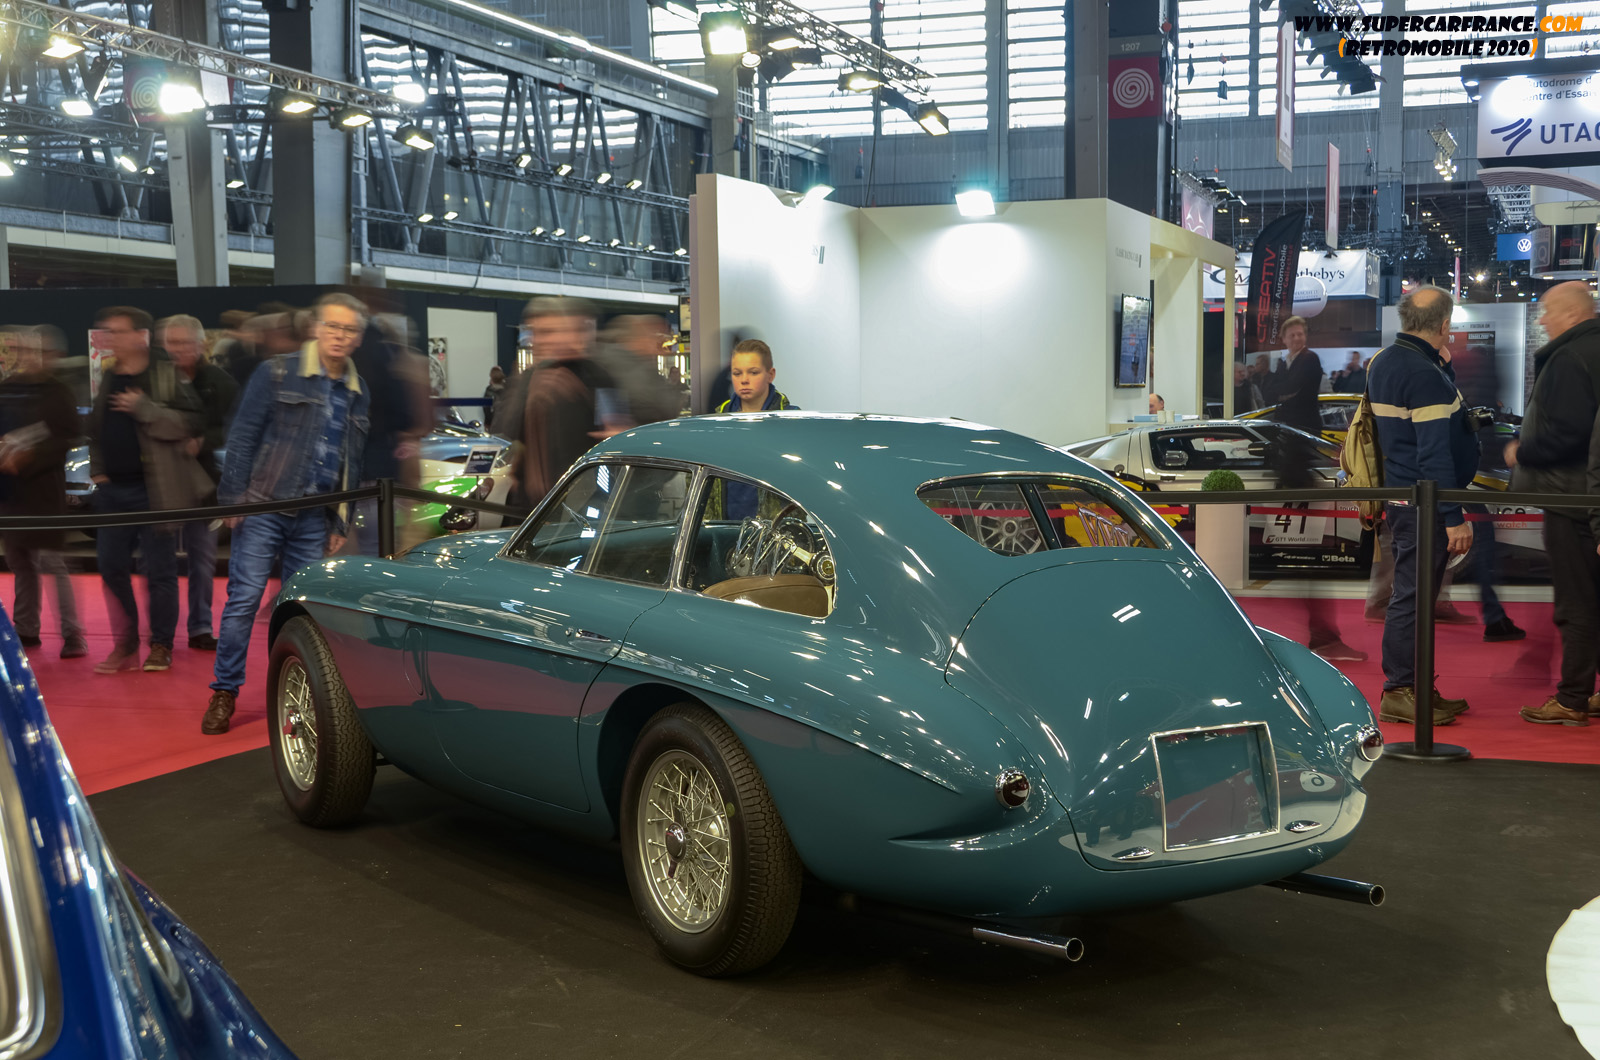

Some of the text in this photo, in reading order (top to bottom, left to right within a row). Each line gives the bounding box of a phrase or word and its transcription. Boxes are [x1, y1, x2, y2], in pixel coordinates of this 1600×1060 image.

[1121, 43, 1140, 51] 1207
[1270, 302, 1280, 345] Expertise
[1275, 244, 1288, 298] Automobile
